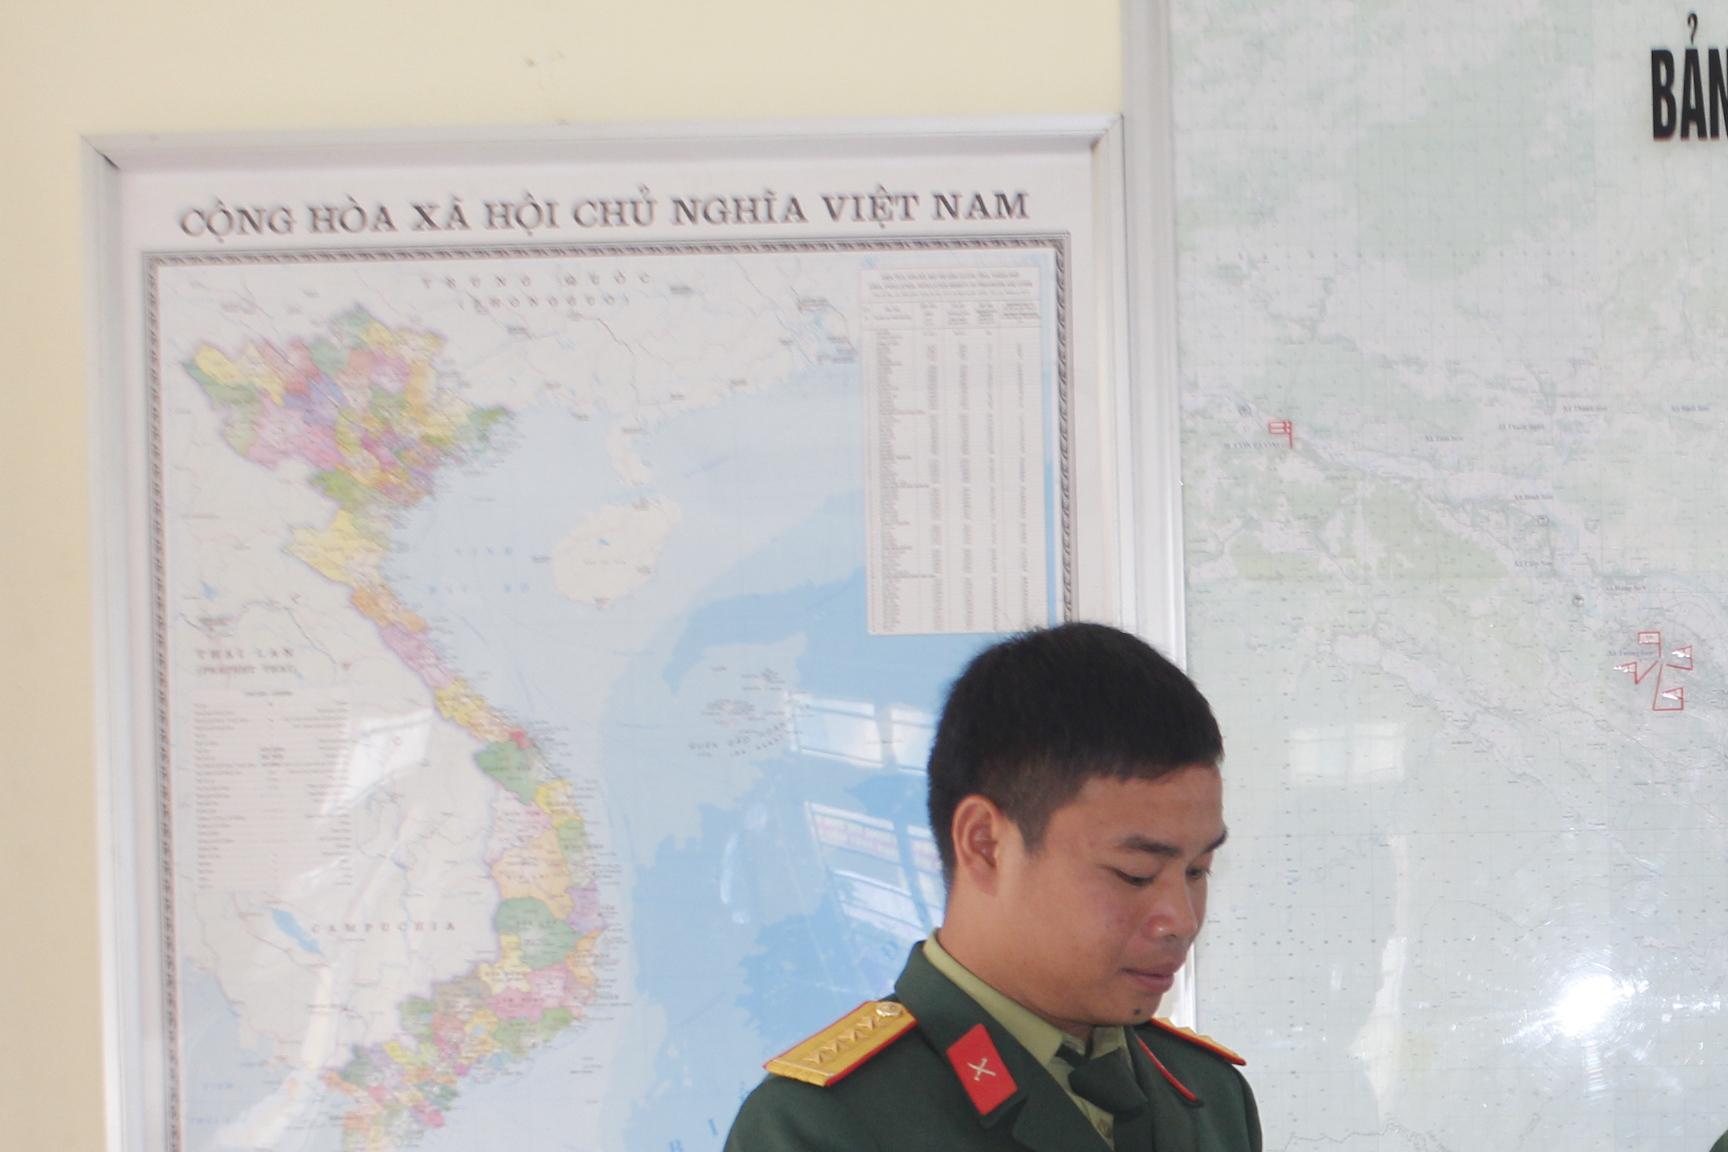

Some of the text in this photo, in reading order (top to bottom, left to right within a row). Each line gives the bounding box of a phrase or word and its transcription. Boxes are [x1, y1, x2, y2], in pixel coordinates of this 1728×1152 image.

[179, 183, 1031, 243] CỘNG HÒA XÃ HỘI CHỦ NGHĨA VIỆT NAM
